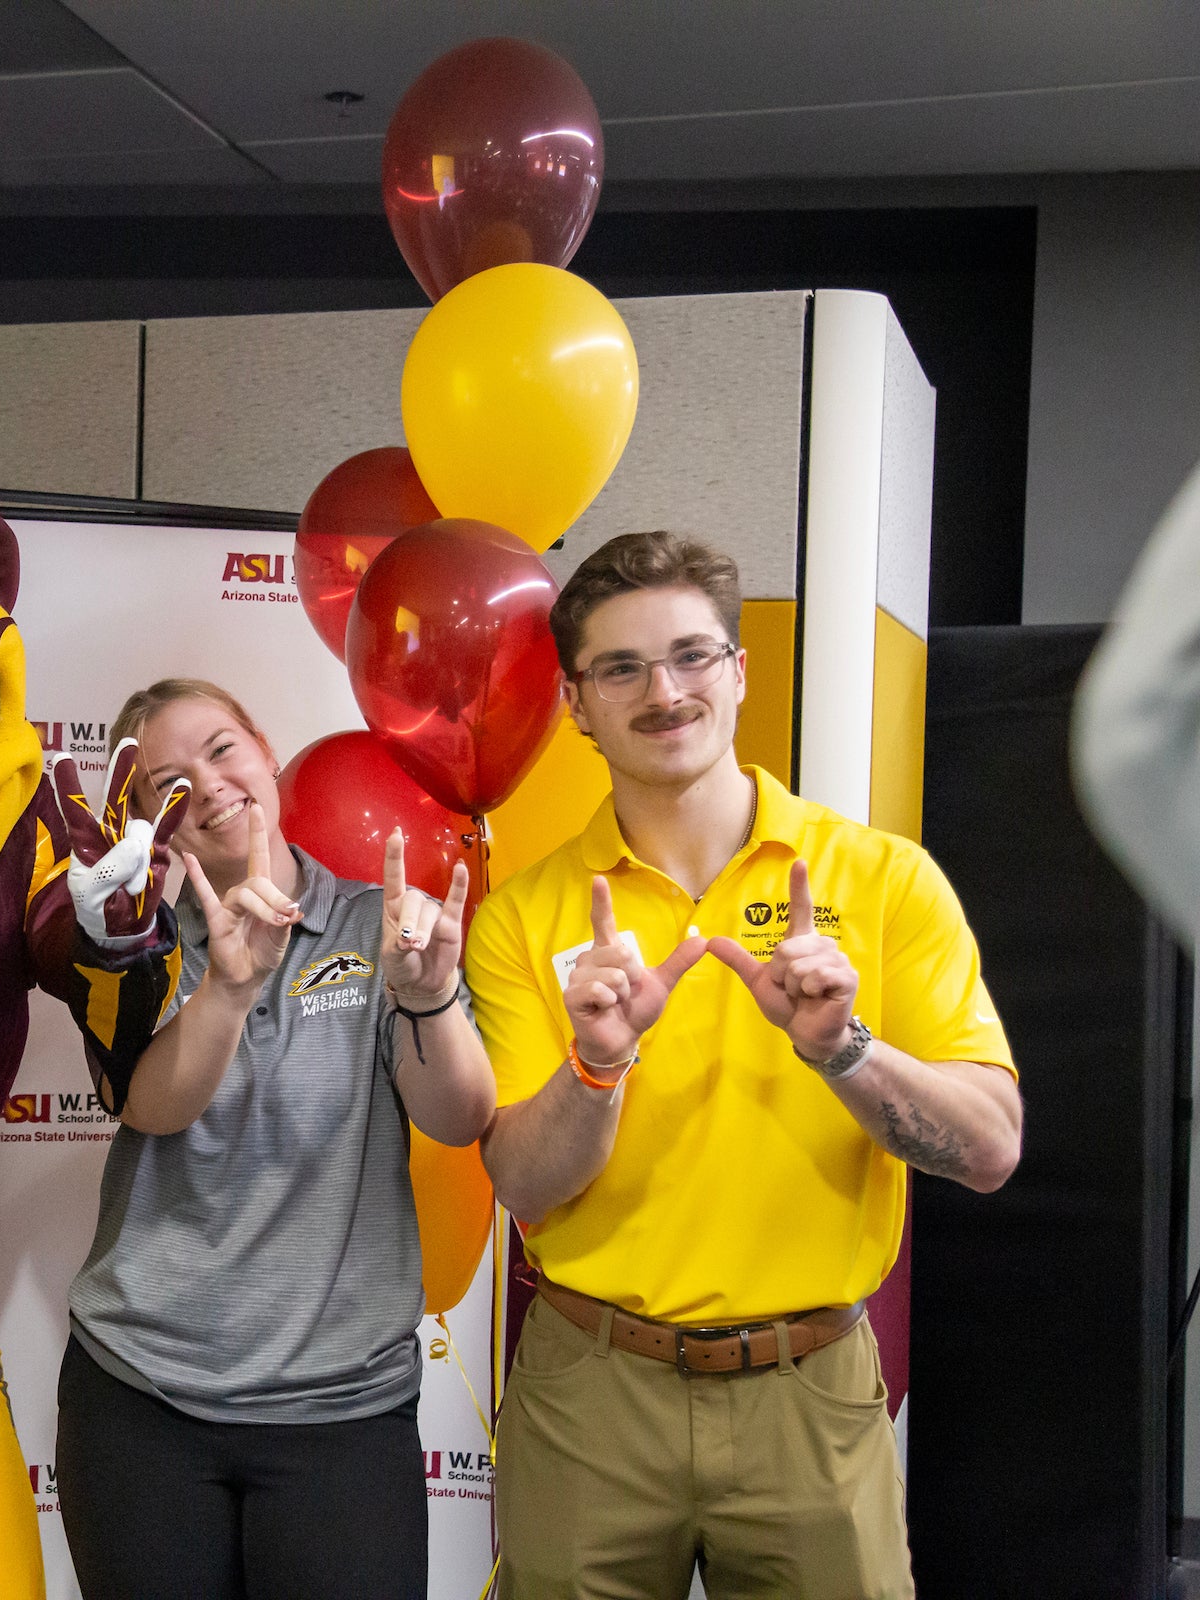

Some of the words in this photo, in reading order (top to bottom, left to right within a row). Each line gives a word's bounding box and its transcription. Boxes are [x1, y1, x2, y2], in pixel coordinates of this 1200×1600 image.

[222, 552, 285, 584] ASU
[221, 590, 266, 602] Arizona
[268, 592, 298, 603] State
[70, 722, 95, 741] W.
[70, 743, 106, 753] School
[301, 986, 358, 1006] WESTERN
[302, 994, 367, 1017] MICHIGAN
[2, 1094, 52, 1124] SU
[58, 1093, 83, 1112] W.
[58, 1114, 93, 1123] School
[96, 1114, 107, 1123] of
[34, 1131, 65, 1142] State
[68, 1131, 115, 1142] Universi
[449, 1451, 473, 1470] W.
[448, 1471, 485, 1482] School
[426, 1487, 456, 1498] State
[458, 1488, 492, 1501] Unive
